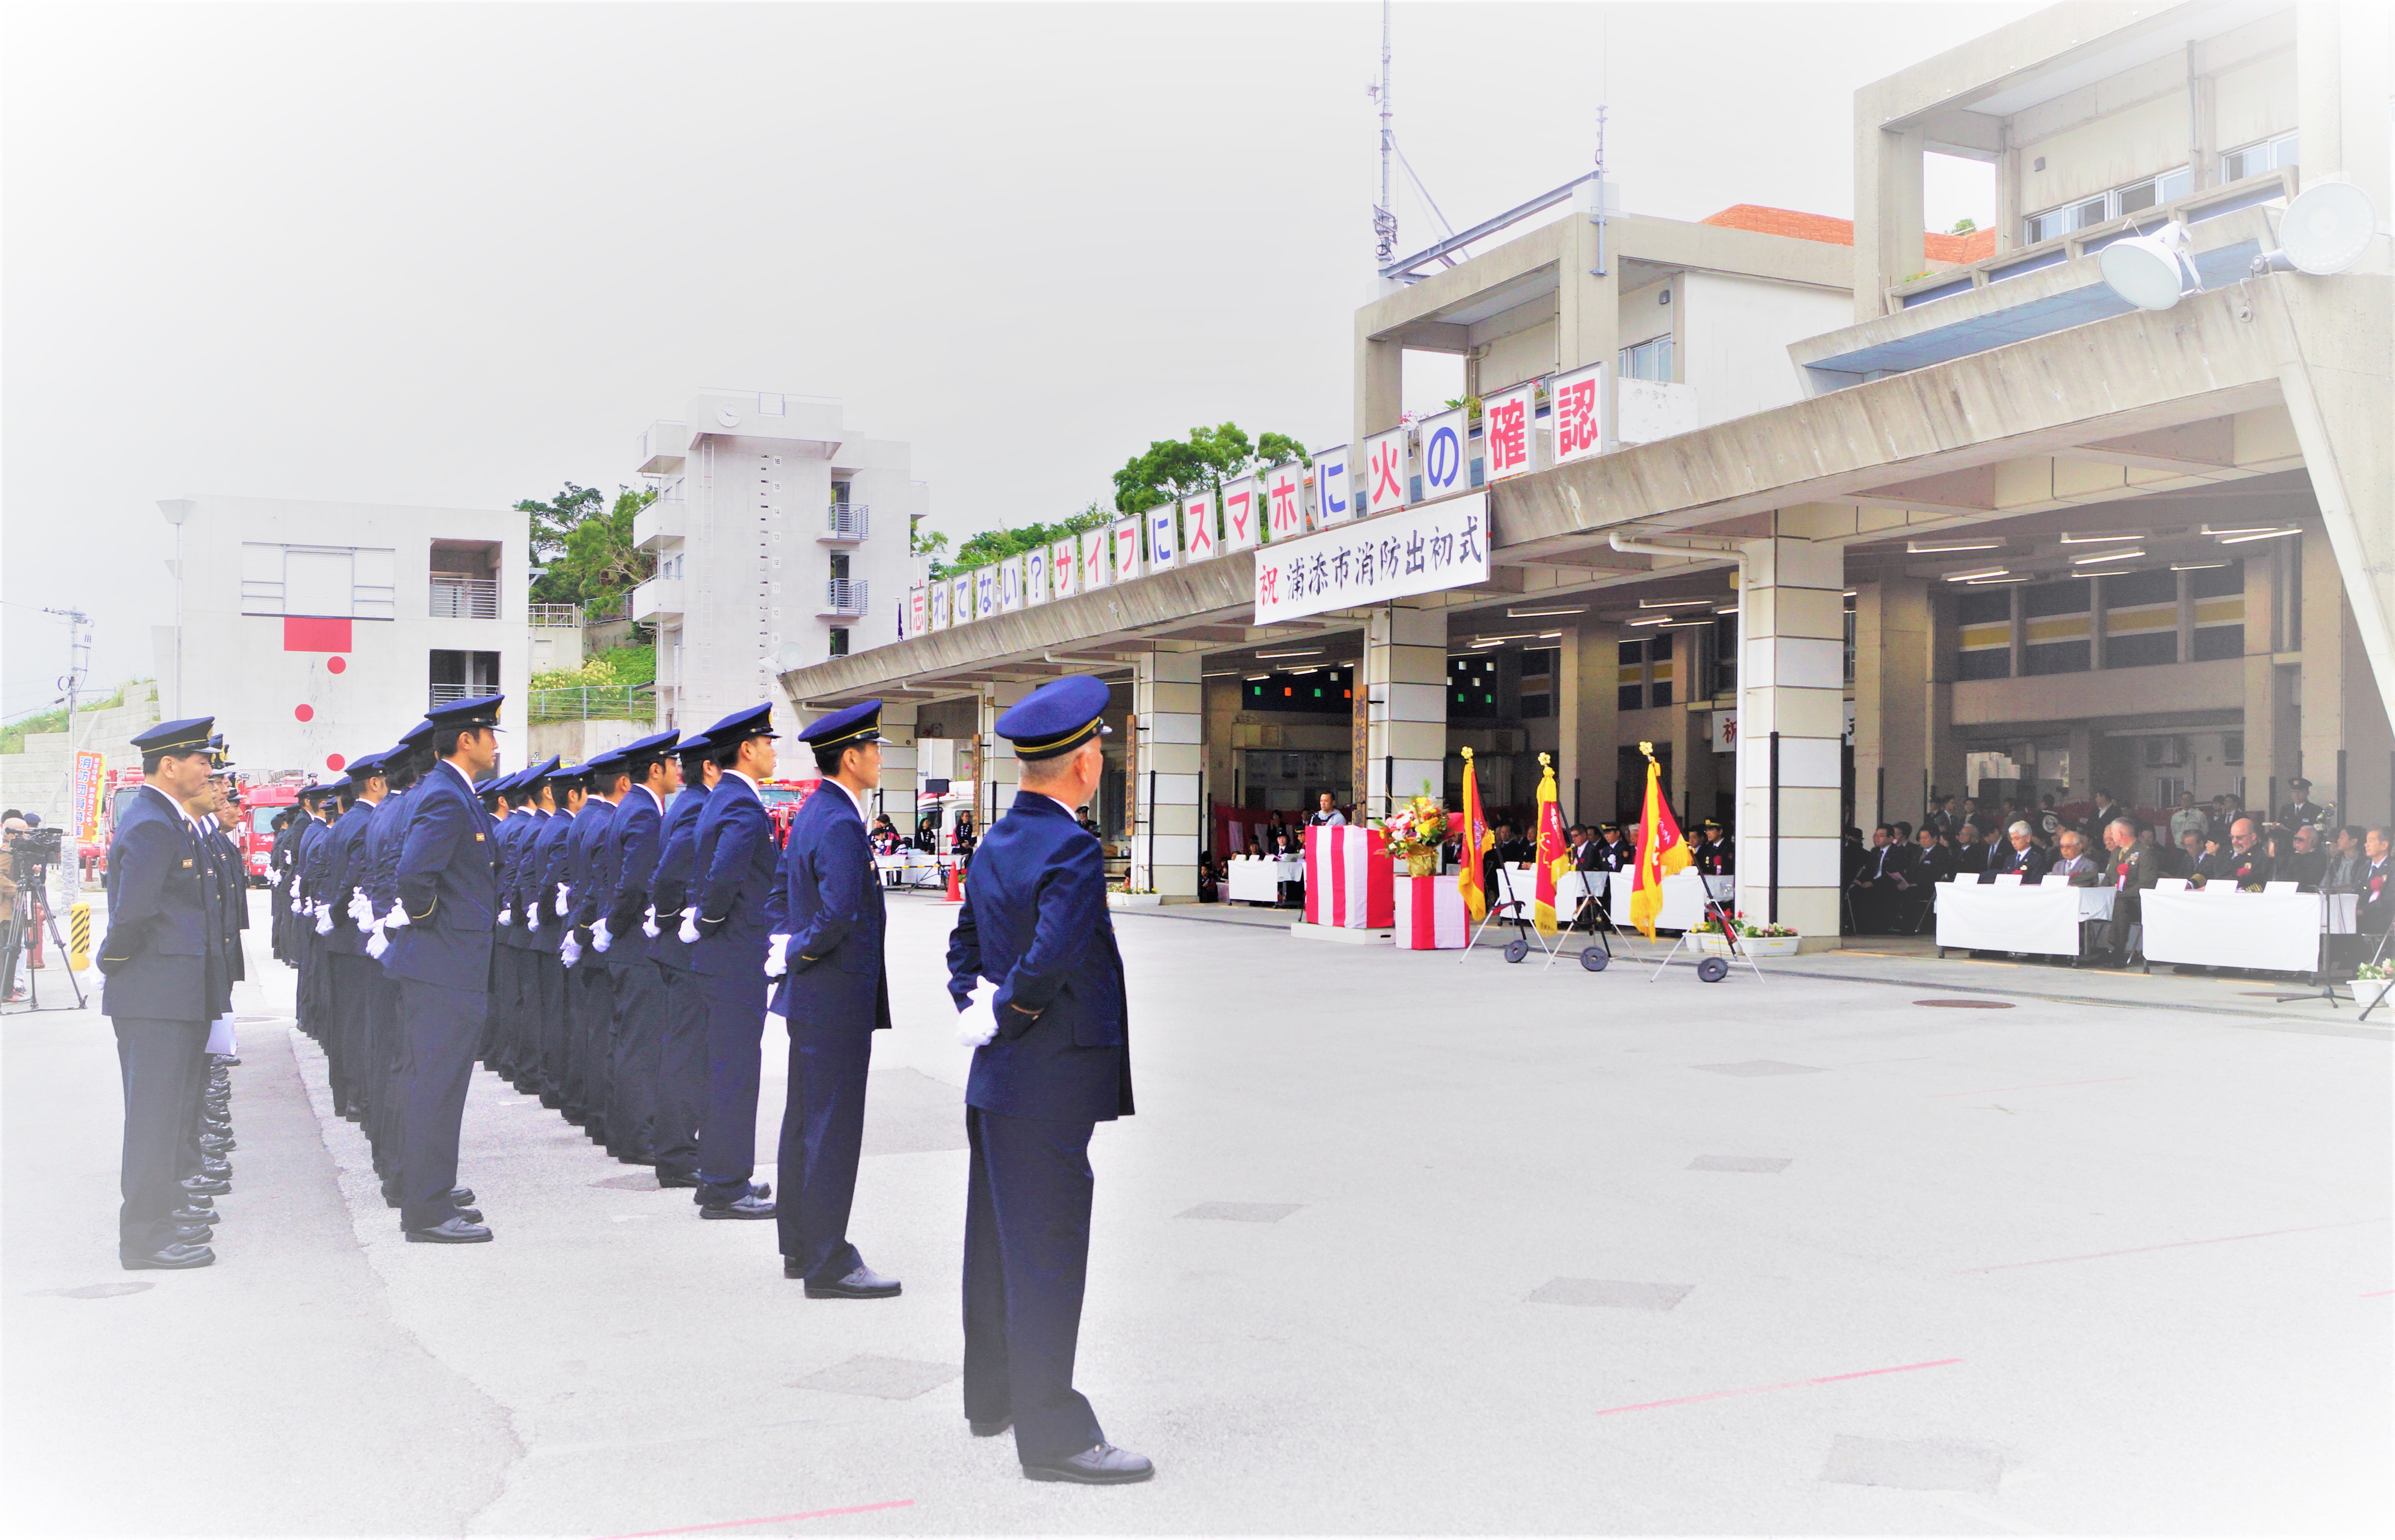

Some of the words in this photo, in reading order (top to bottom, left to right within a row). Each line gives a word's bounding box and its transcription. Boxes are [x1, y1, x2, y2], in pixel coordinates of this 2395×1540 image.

[1259, 565, 1279, 606] 祝
[1287, 515, 1482, 602] 浦添市消防出初式
[76, 756, 92, 837] 消防団員募集
